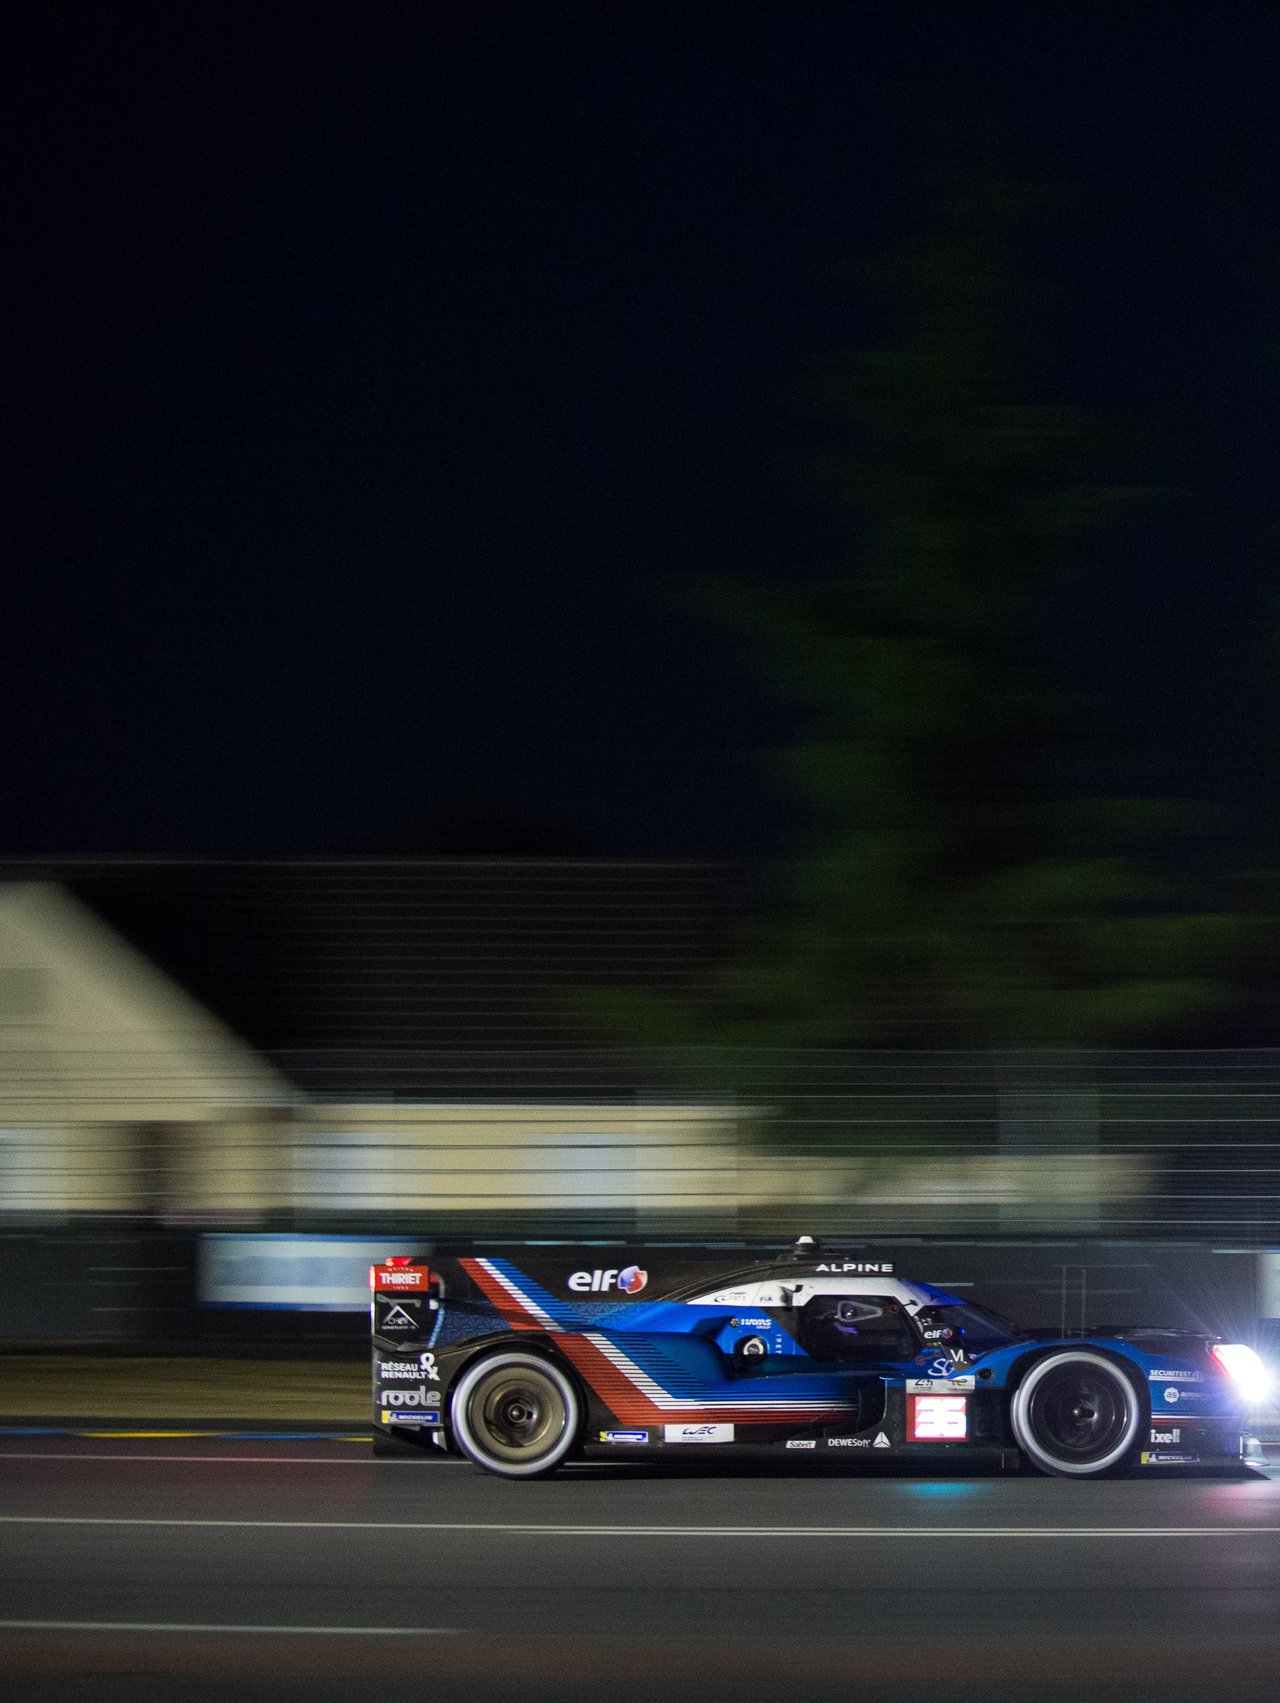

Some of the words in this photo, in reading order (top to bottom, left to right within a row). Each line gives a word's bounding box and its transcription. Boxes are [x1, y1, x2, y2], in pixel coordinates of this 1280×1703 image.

[815, 1263, 894, 1272] ALPINE
[379, 1272, 423, 1285] THIRIET
[568, 1269, 619, 1292] elf
[740, 1318, 772, 1326] HAVAS
[923, 1329, 942, 1339] elf
[380, 1361, 418, 1372] RÉSEAU
[380, 1371, 427, 1379] RENAULT
[1150, 1369, 1192, 1377] SECURITEST
[381, 1385, 442, 1407] roole
[914, 1398, 967, 1438] 36
[682, 1426, 717, 1435] WEC
[1150, 1428, 1181, 1444] ixell
[828, 1438, 869, 1447] DEWESoft
